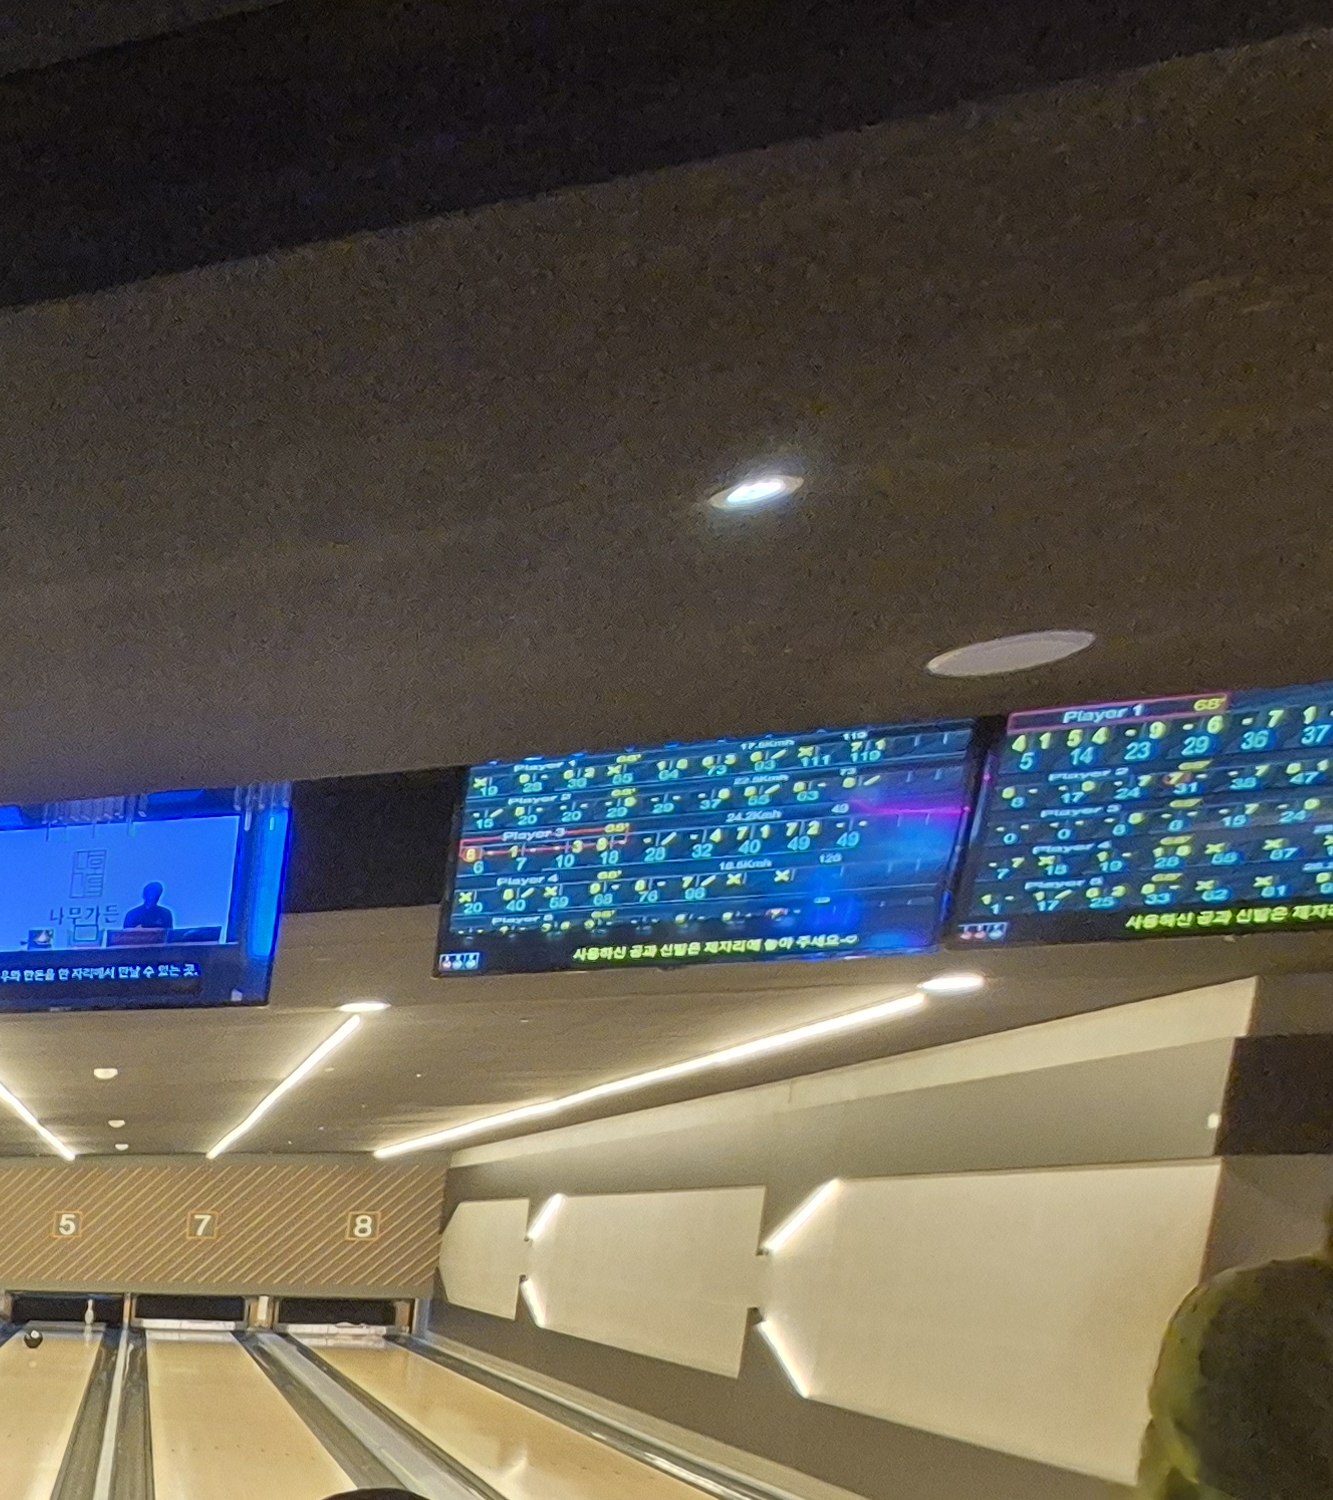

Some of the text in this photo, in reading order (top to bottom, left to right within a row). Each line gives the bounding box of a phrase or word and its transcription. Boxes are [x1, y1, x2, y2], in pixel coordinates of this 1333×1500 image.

[1063, 708, 1128, 724] Player
[1133, 703, 1144, 716] 1
[1039, 732, 1051, 749] 1
[1067, 729, 1083, 747] 5
[1091, 726, 1109, 744] 4
[1207, 715, 1223, 734] 6
[1268, 710, 1284, 728] 7
[1019, 724, 1332, 770] 5 14 23 29 36 37
[801, 755, 831, 767] 111
[1173, 782, 1198, 795] 31
[1289, 771, 1321, 785] 47
[518, 814, 537, 826] 20
[561, 811, 582, 822] 20
[502, 830, 552, 842] Player
[553, 827, 566, 837] 3
[473, 861, 484, 874] 6
[516, 857, 527, 871] 7
[556, 854, 575, 868] 10
[600, 850, 619, 864] 18
[691, 843, 713, 859] 32
[738, 839, 761, 854] 40
[787, 835, 811, 851] 49
[837, 831, 861, 847] 49
[497, 876, 546, 886] Player
[50, 904, 119, 925] 나무가든
[463, 902, 483, 914] 20
[506, 899, 526, 912] 40
[1126, 912, 1195, 930] 사용하신
[143, 966, 155, 978] 수
[58, 1215, 76, 1235] 5
[194, 1215, 212, 1235] 7
[354, 1216, 372, 1237] 8
